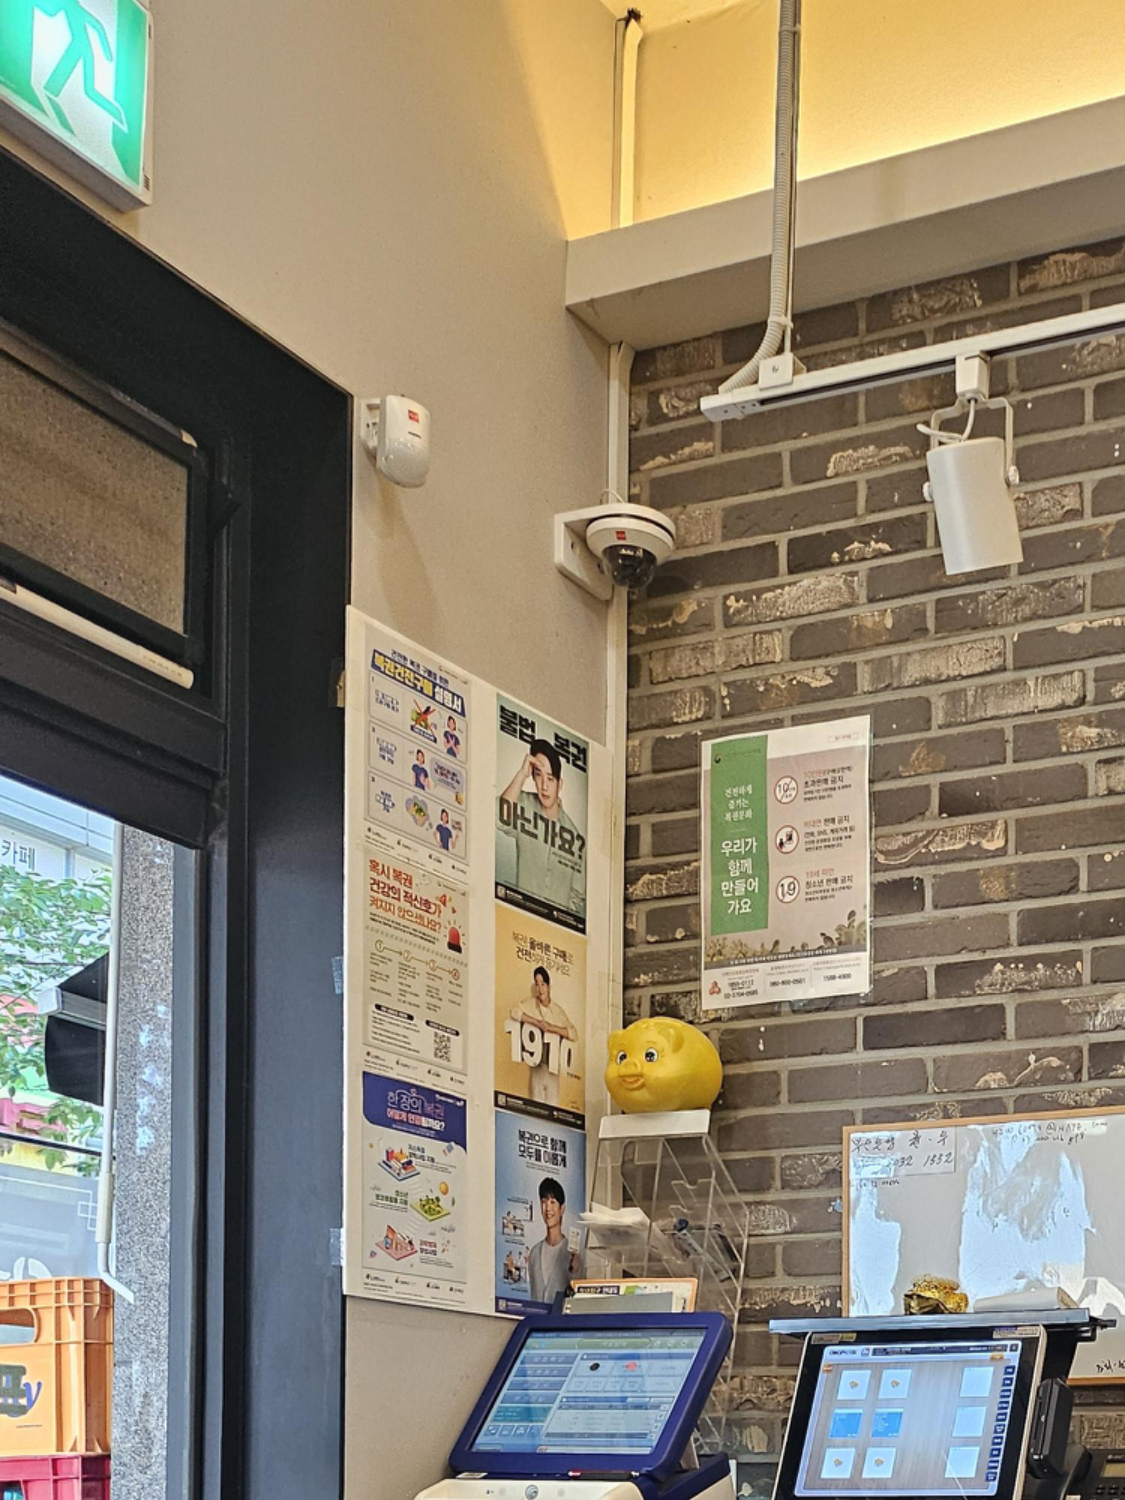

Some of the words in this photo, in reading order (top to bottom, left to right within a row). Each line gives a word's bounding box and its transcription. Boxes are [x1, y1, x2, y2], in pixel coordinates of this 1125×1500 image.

[499, 704, 536, 746] 불법
[554, 732, 587, 773] 복권
[499, 797, 586, 860] 아닌가요?
[1, 839, 35, 871] 카페
[721, 837, 757, 857] 우리가
[368, 859, 390, 881] 혹시
[393, 868, 413, 889] 복권
[728, 858, 752, 876] 함께
[369, 877, 401, 902] 건강의
[404, 890, 442, 918] 적신호가
[721, 877, 758, 897] 만들어
[780, 881, 796, 898] 19
[369, 896, 396, 917] 켜지지
[728, 898, 752, 915] 가요
[529, 937, 551, 957] 올바른
[518, 1130, 549, 1149] 복권으로
[550, 1137, 567, 1155] 함께
[518, 1145, 541, 1162] 모두를
[543, 1152, 567, 1168] 이롭게
[924, 1152, 953, 1167] 1552
